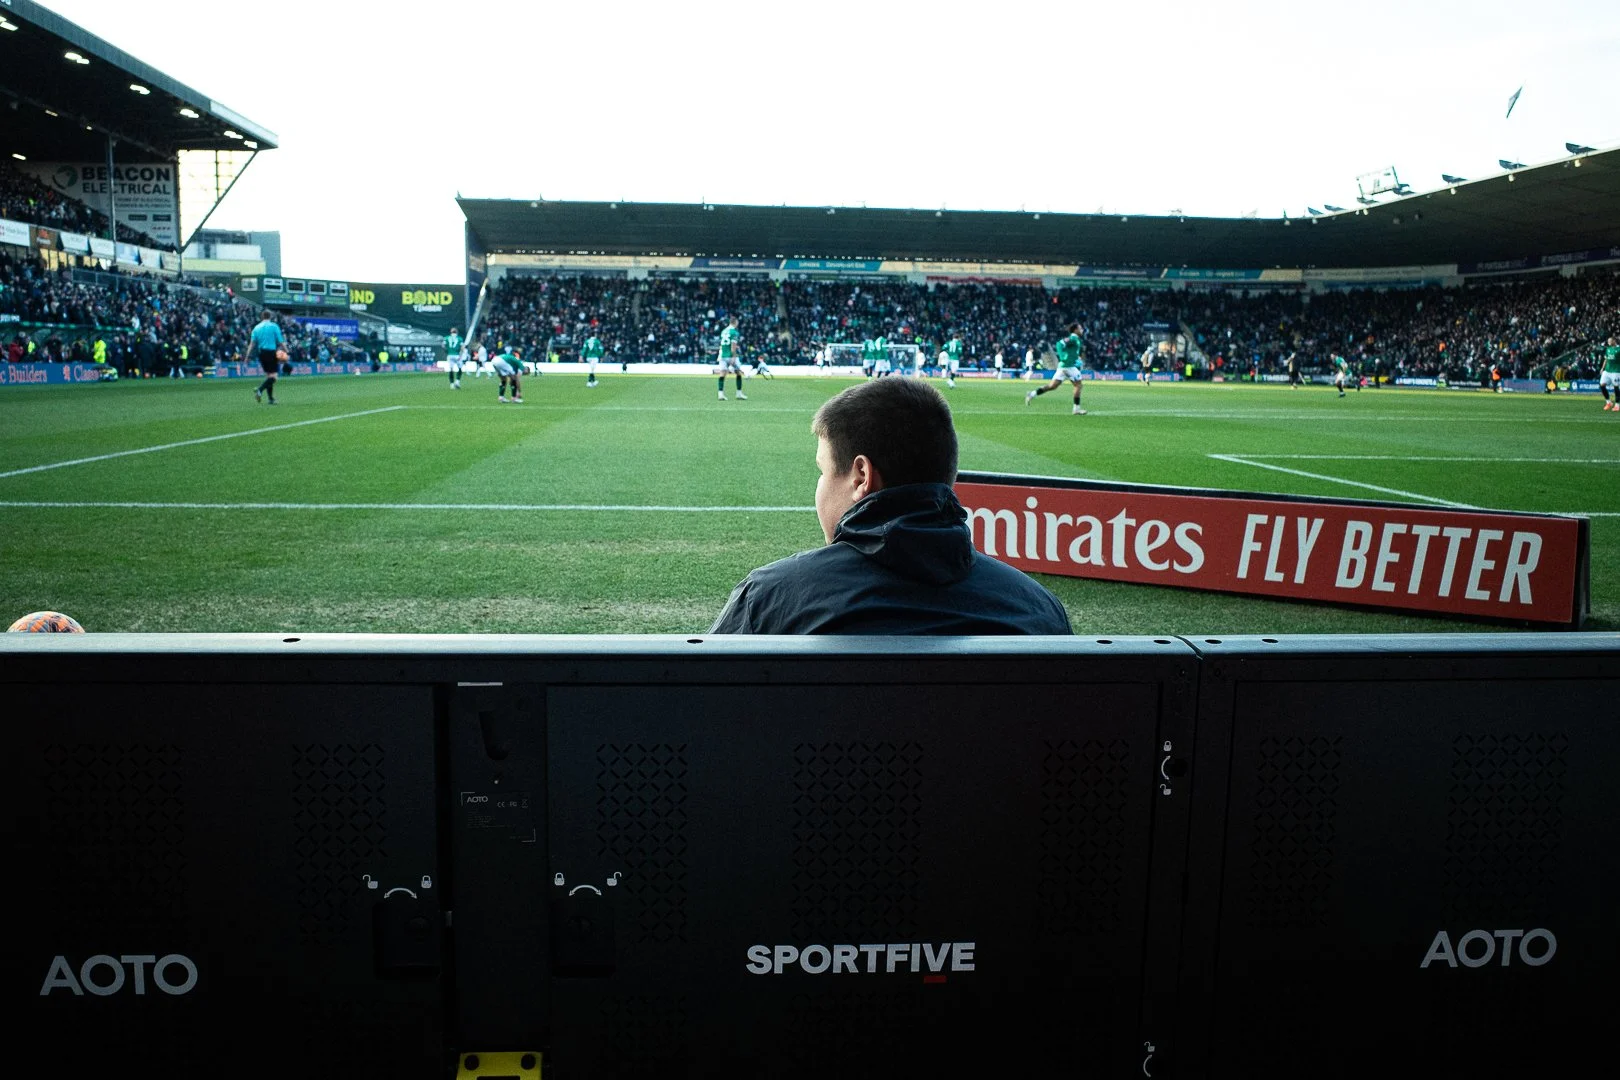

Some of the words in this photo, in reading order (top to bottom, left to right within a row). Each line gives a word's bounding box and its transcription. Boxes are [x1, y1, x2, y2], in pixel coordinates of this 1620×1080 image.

[82, 167, 170, 181] BEACON
[350, 289, 375, 304] ND
[402, 290, 453, 306] BOND
[8, 364, 48, 383] Builders
[962, 495, 1204, 574] mirates
[1236, 513, 1325, 585] FLY
[1334, 519, 1543, 605] BETTER
[466, 796, 489, 804] AOTO
[745, 941, 976, 975] SPORTFIVE
[1420, 928, 1558, 969] AOTO
[39, 953, 200, 996] AOTO
